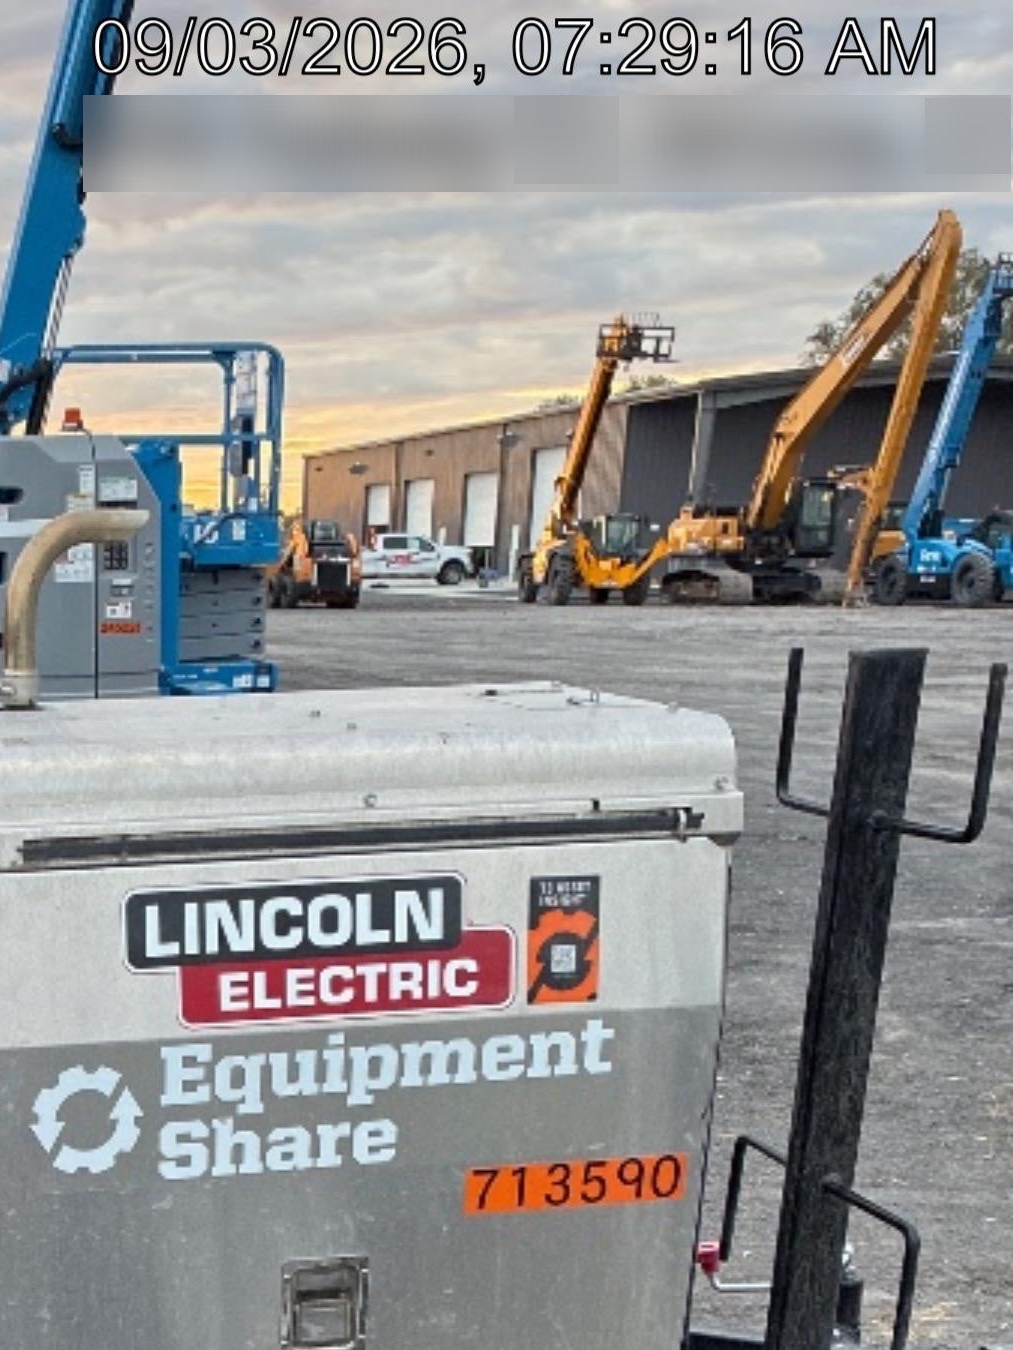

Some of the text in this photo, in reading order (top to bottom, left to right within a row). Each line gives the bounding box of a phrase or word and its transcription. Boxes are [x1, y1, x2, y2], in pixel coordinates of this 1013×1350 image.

[144, 887, 445, 958] LINCOLN
[217, 957, 479, 1012] ELECTRIC
[159, 1018, 616, 1115] Equipment
[157, 1116, 399, 1181] Share
[472, 1154, 682, 1209] 713590
